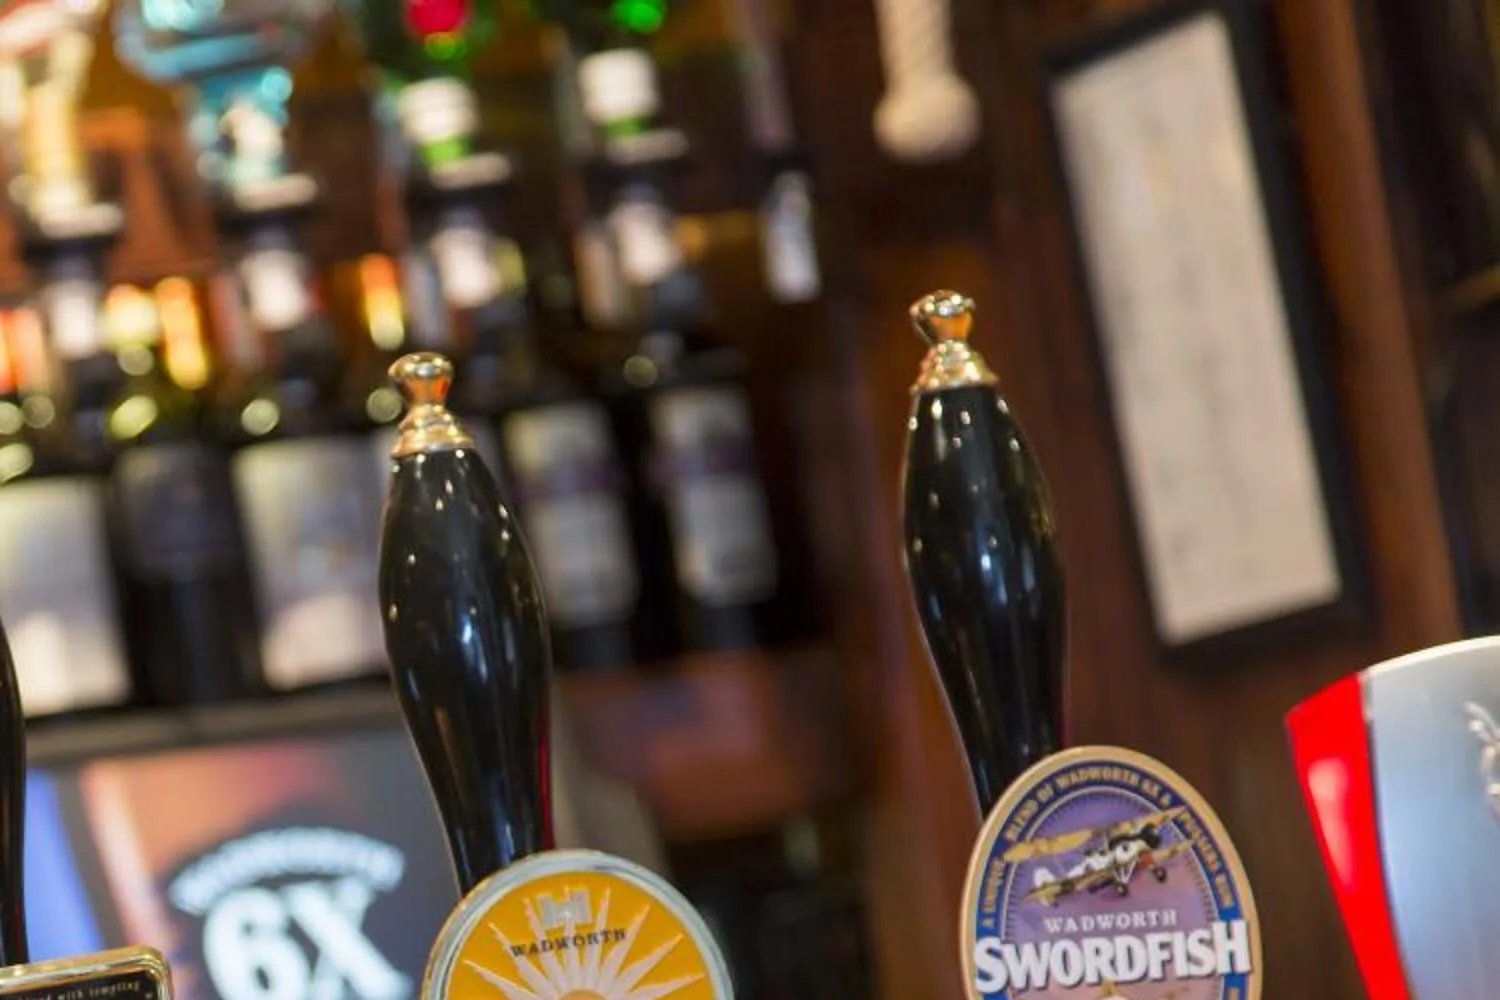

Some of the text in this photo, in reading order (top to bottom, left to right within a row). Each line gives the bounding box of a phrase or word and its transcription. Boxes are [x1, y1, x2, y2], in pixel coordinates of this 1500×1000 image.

[1055, 766, 1140, 788] WADWORTH
[1044, 909, 1178, 934] WADWORTH
[511, 928, 627, 957] WADWORTH
[975, 920, 1251, 993] SWORDFISH
